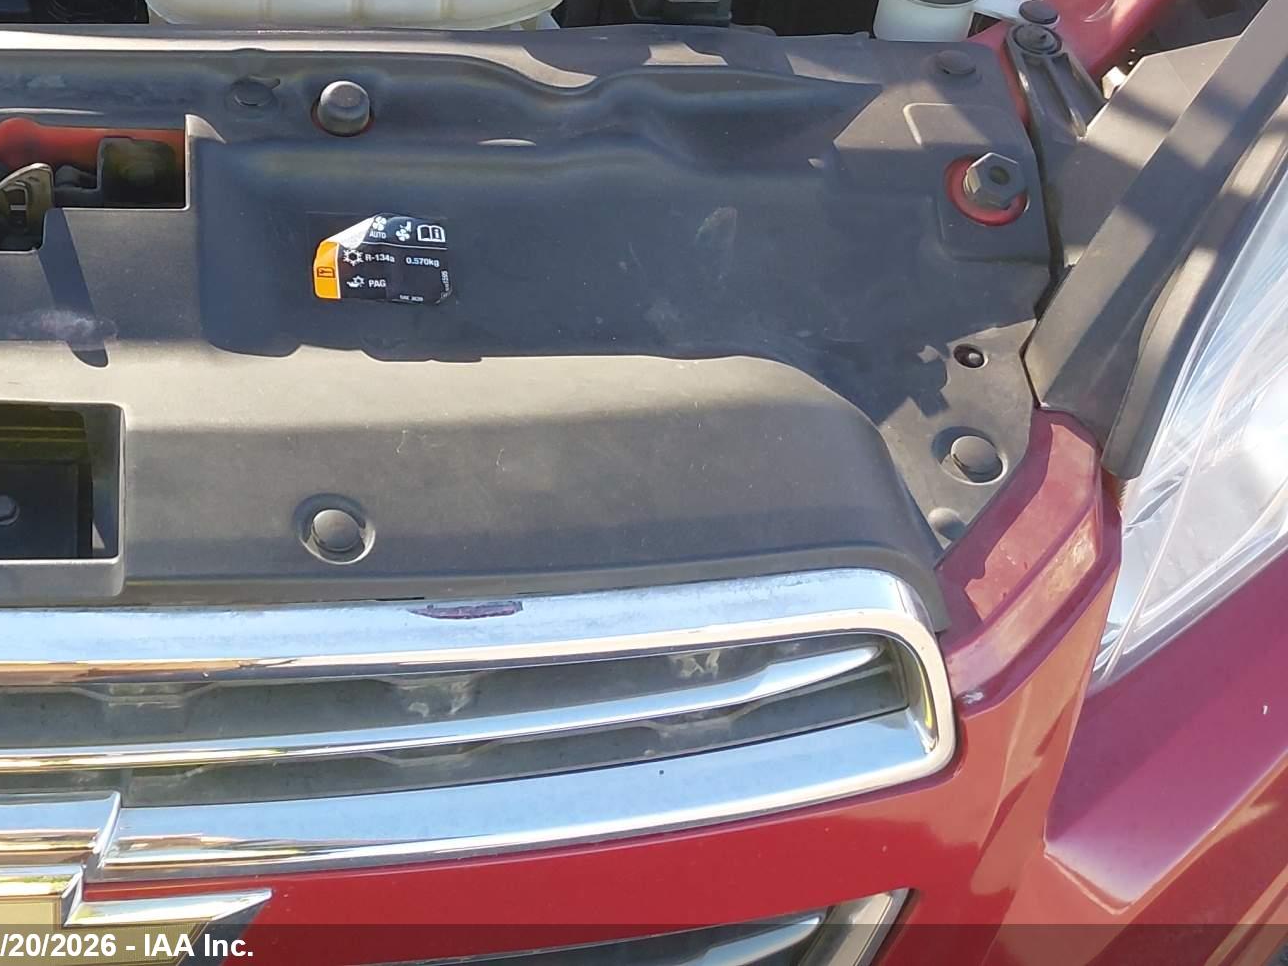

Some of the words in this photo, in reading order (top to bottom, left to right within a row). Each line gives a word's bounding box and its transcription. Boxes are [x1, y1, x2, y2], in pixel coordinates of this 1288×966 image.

[369, 230, 387, 239] AUTO
[364, 254, 395, 263] R-134a
[405, 256, 440, 268] 0.570kg
[368, 279, 386, 288] PAG
